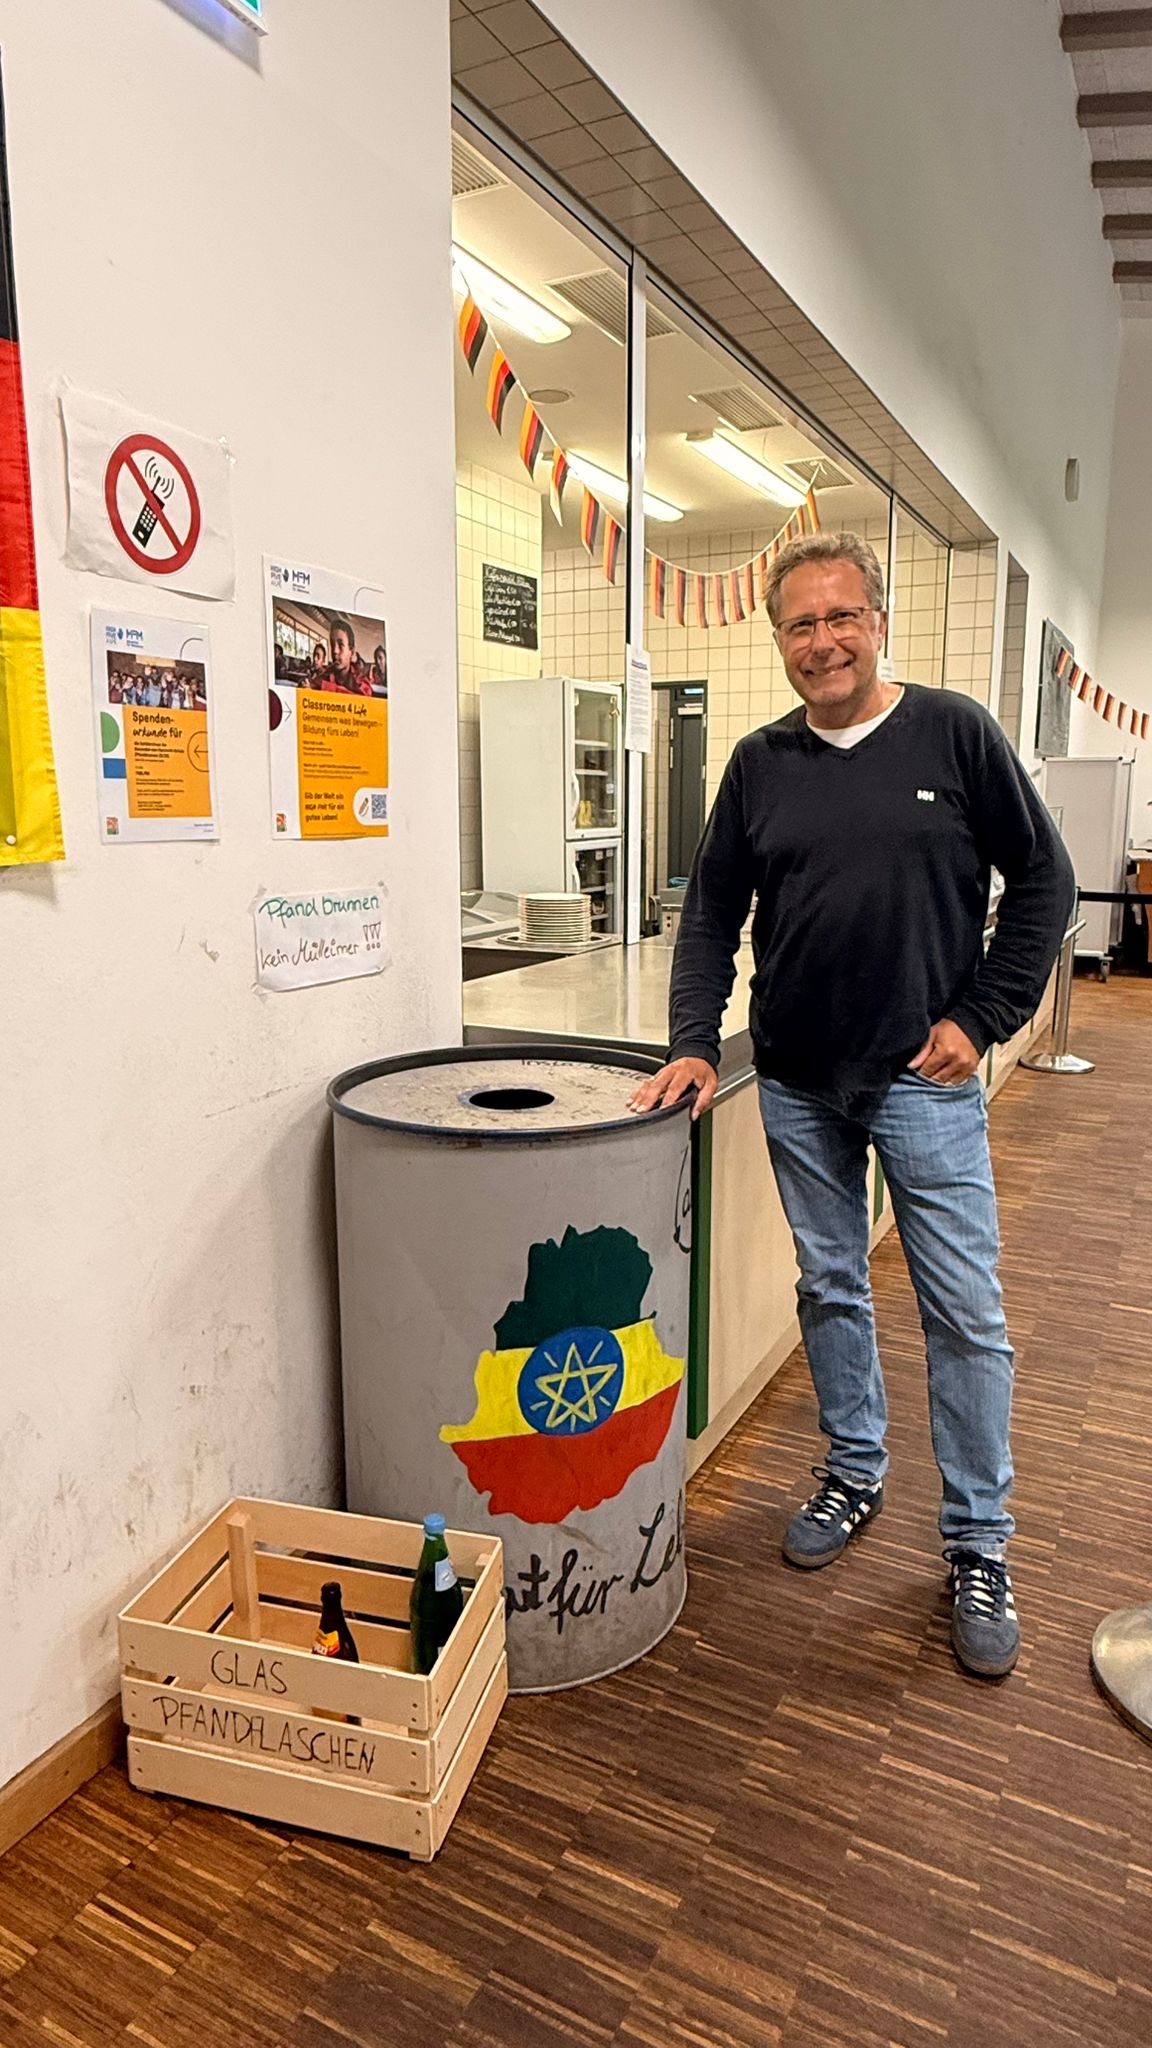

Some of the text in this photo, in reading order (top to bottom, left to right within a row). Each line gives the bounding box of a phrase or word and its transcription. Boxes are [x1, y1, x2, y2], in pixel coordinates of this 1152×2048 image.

[132, 711, 174, 724] Spenden-
[302, 698, 368, 717] Classrooms 4 Life
[302, 711, 339, 724] Gemeinsam
[340, 718, 351, 726] was
[352, 717, 378, 729] bewegen
[132, 726, 183, 738] urkunde für
[302, 724, 359, 737] Bildung fürs Leben!
[259, 896, 318, 928] Pfand
[260, 947, 289, 970] kein
[291, 937, 359, 966] Mülleimer
[547, 1548, 624, 1635] für
[211, 1650, 287, 1694] GLAS
[153, 1696, 376, 1774] PFANDFLASCHEN
